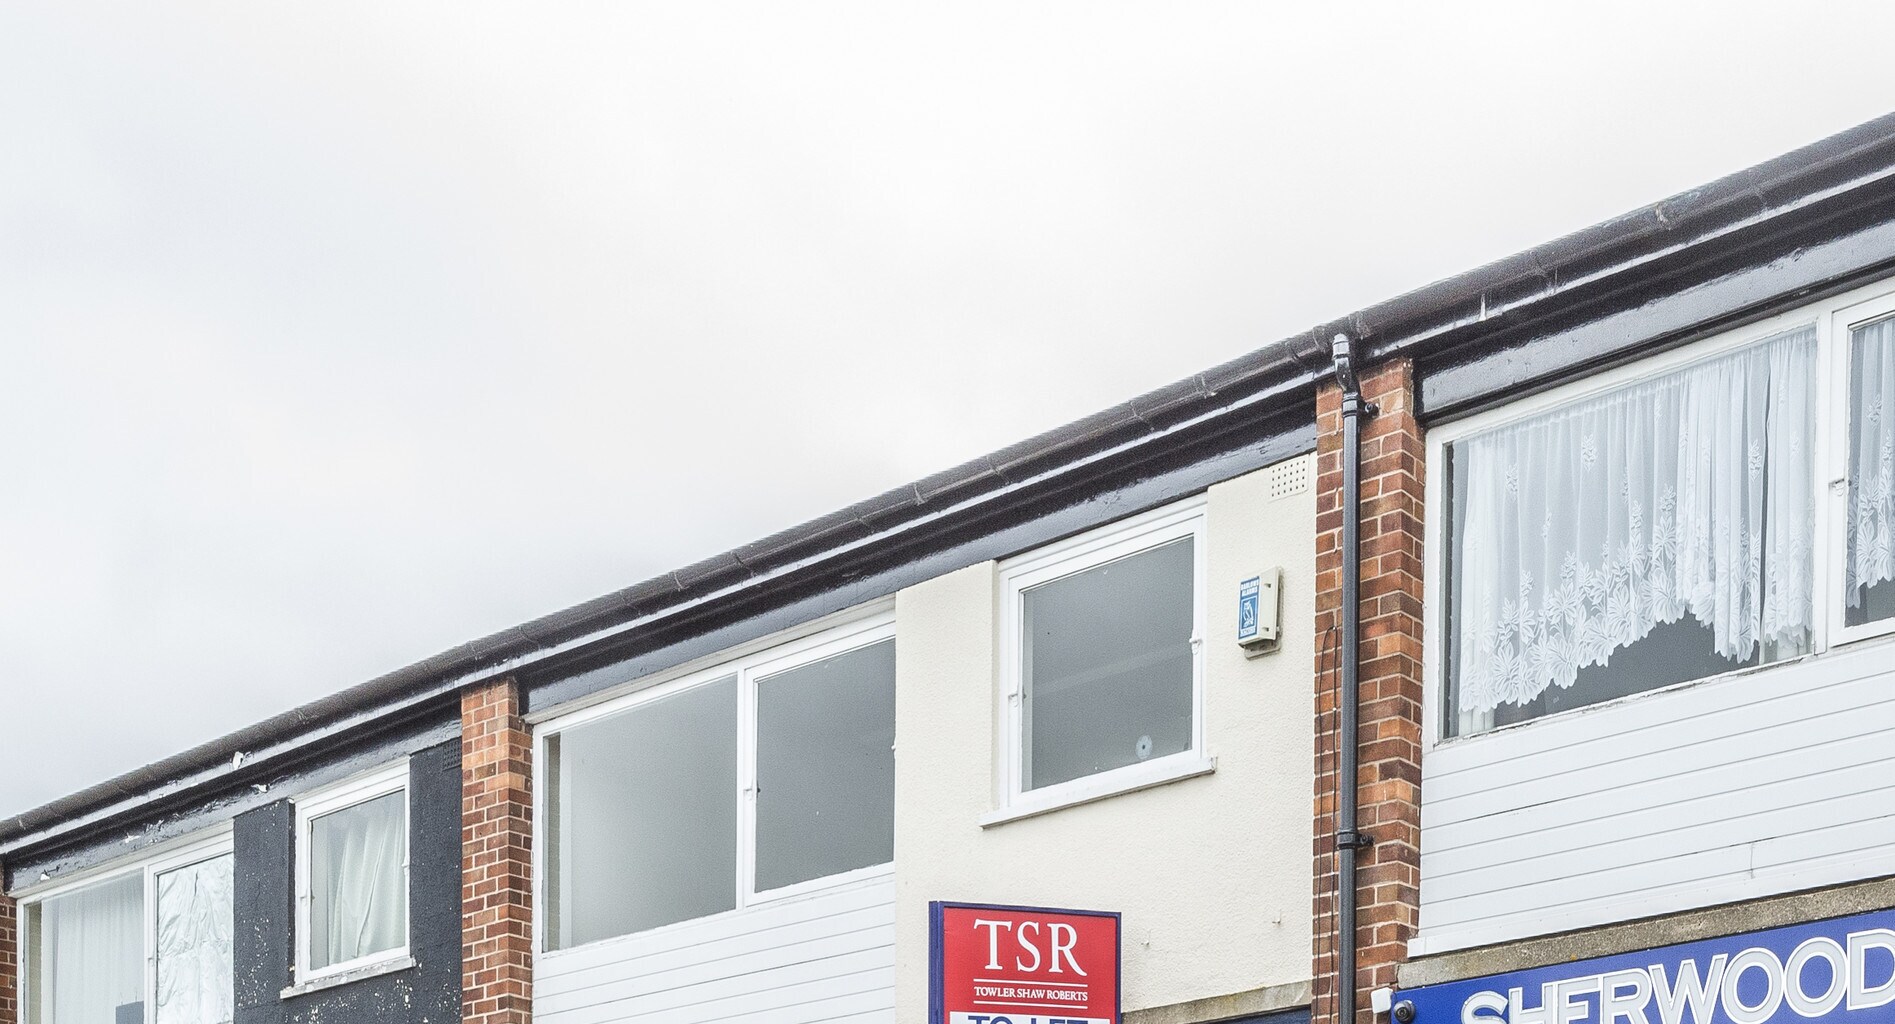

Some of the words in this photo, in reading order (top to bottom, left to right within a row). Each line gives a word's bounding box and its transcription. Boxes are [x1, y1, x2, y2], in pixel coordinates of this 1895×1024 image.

[973, 918, 1087, 977] TSR
[974, 986, 1017, 998] TOWLER
[1017, 989, 1045, 999] SHAW
[1047, 990, 1088, 1001] ROBERTS
